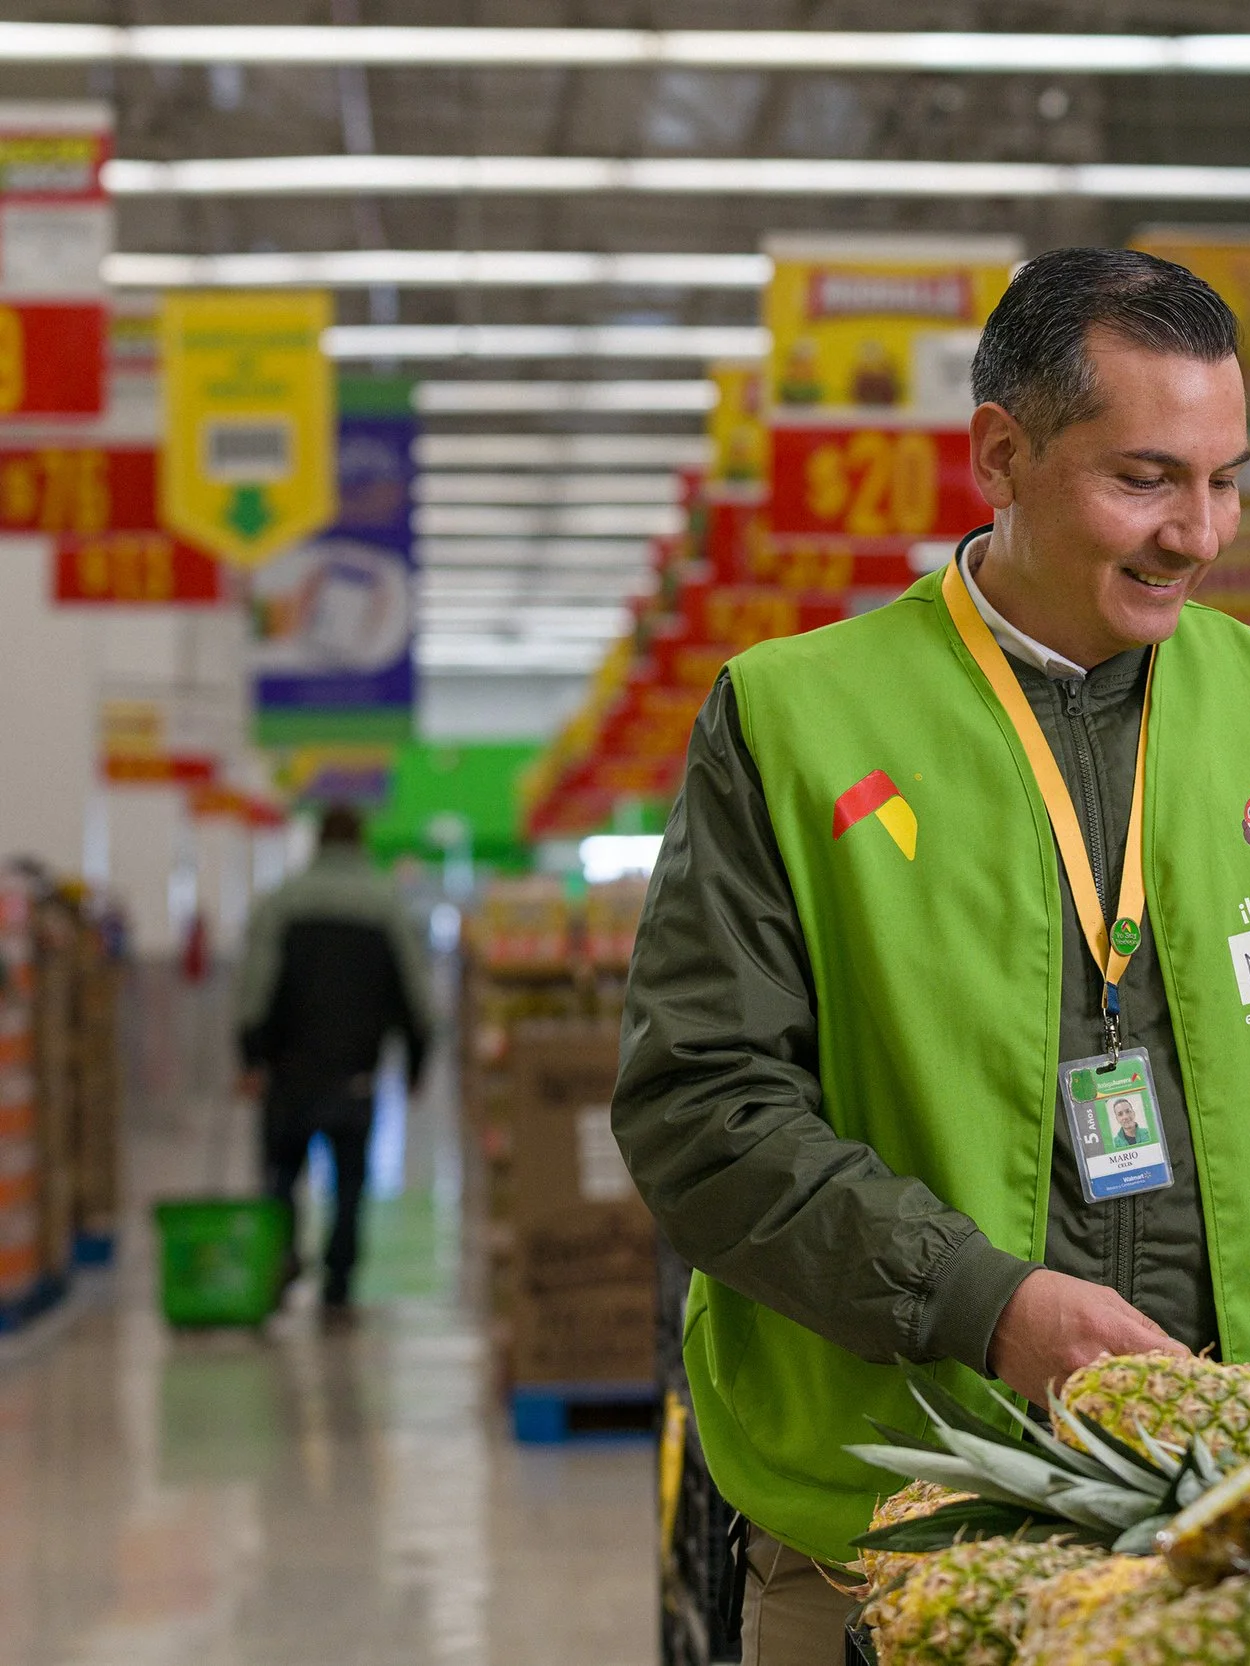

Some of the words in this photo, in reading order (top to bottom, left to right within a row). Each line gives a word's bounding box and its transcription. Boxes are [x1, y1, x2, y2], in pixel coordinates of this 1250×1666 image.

[808, 428, 938, 536] $20
[1086, 1108, 1096, 1130] Años
[1083, 1133, 1099, 1145] 5
[1109, 1151, 1139, 1164] MARIO
